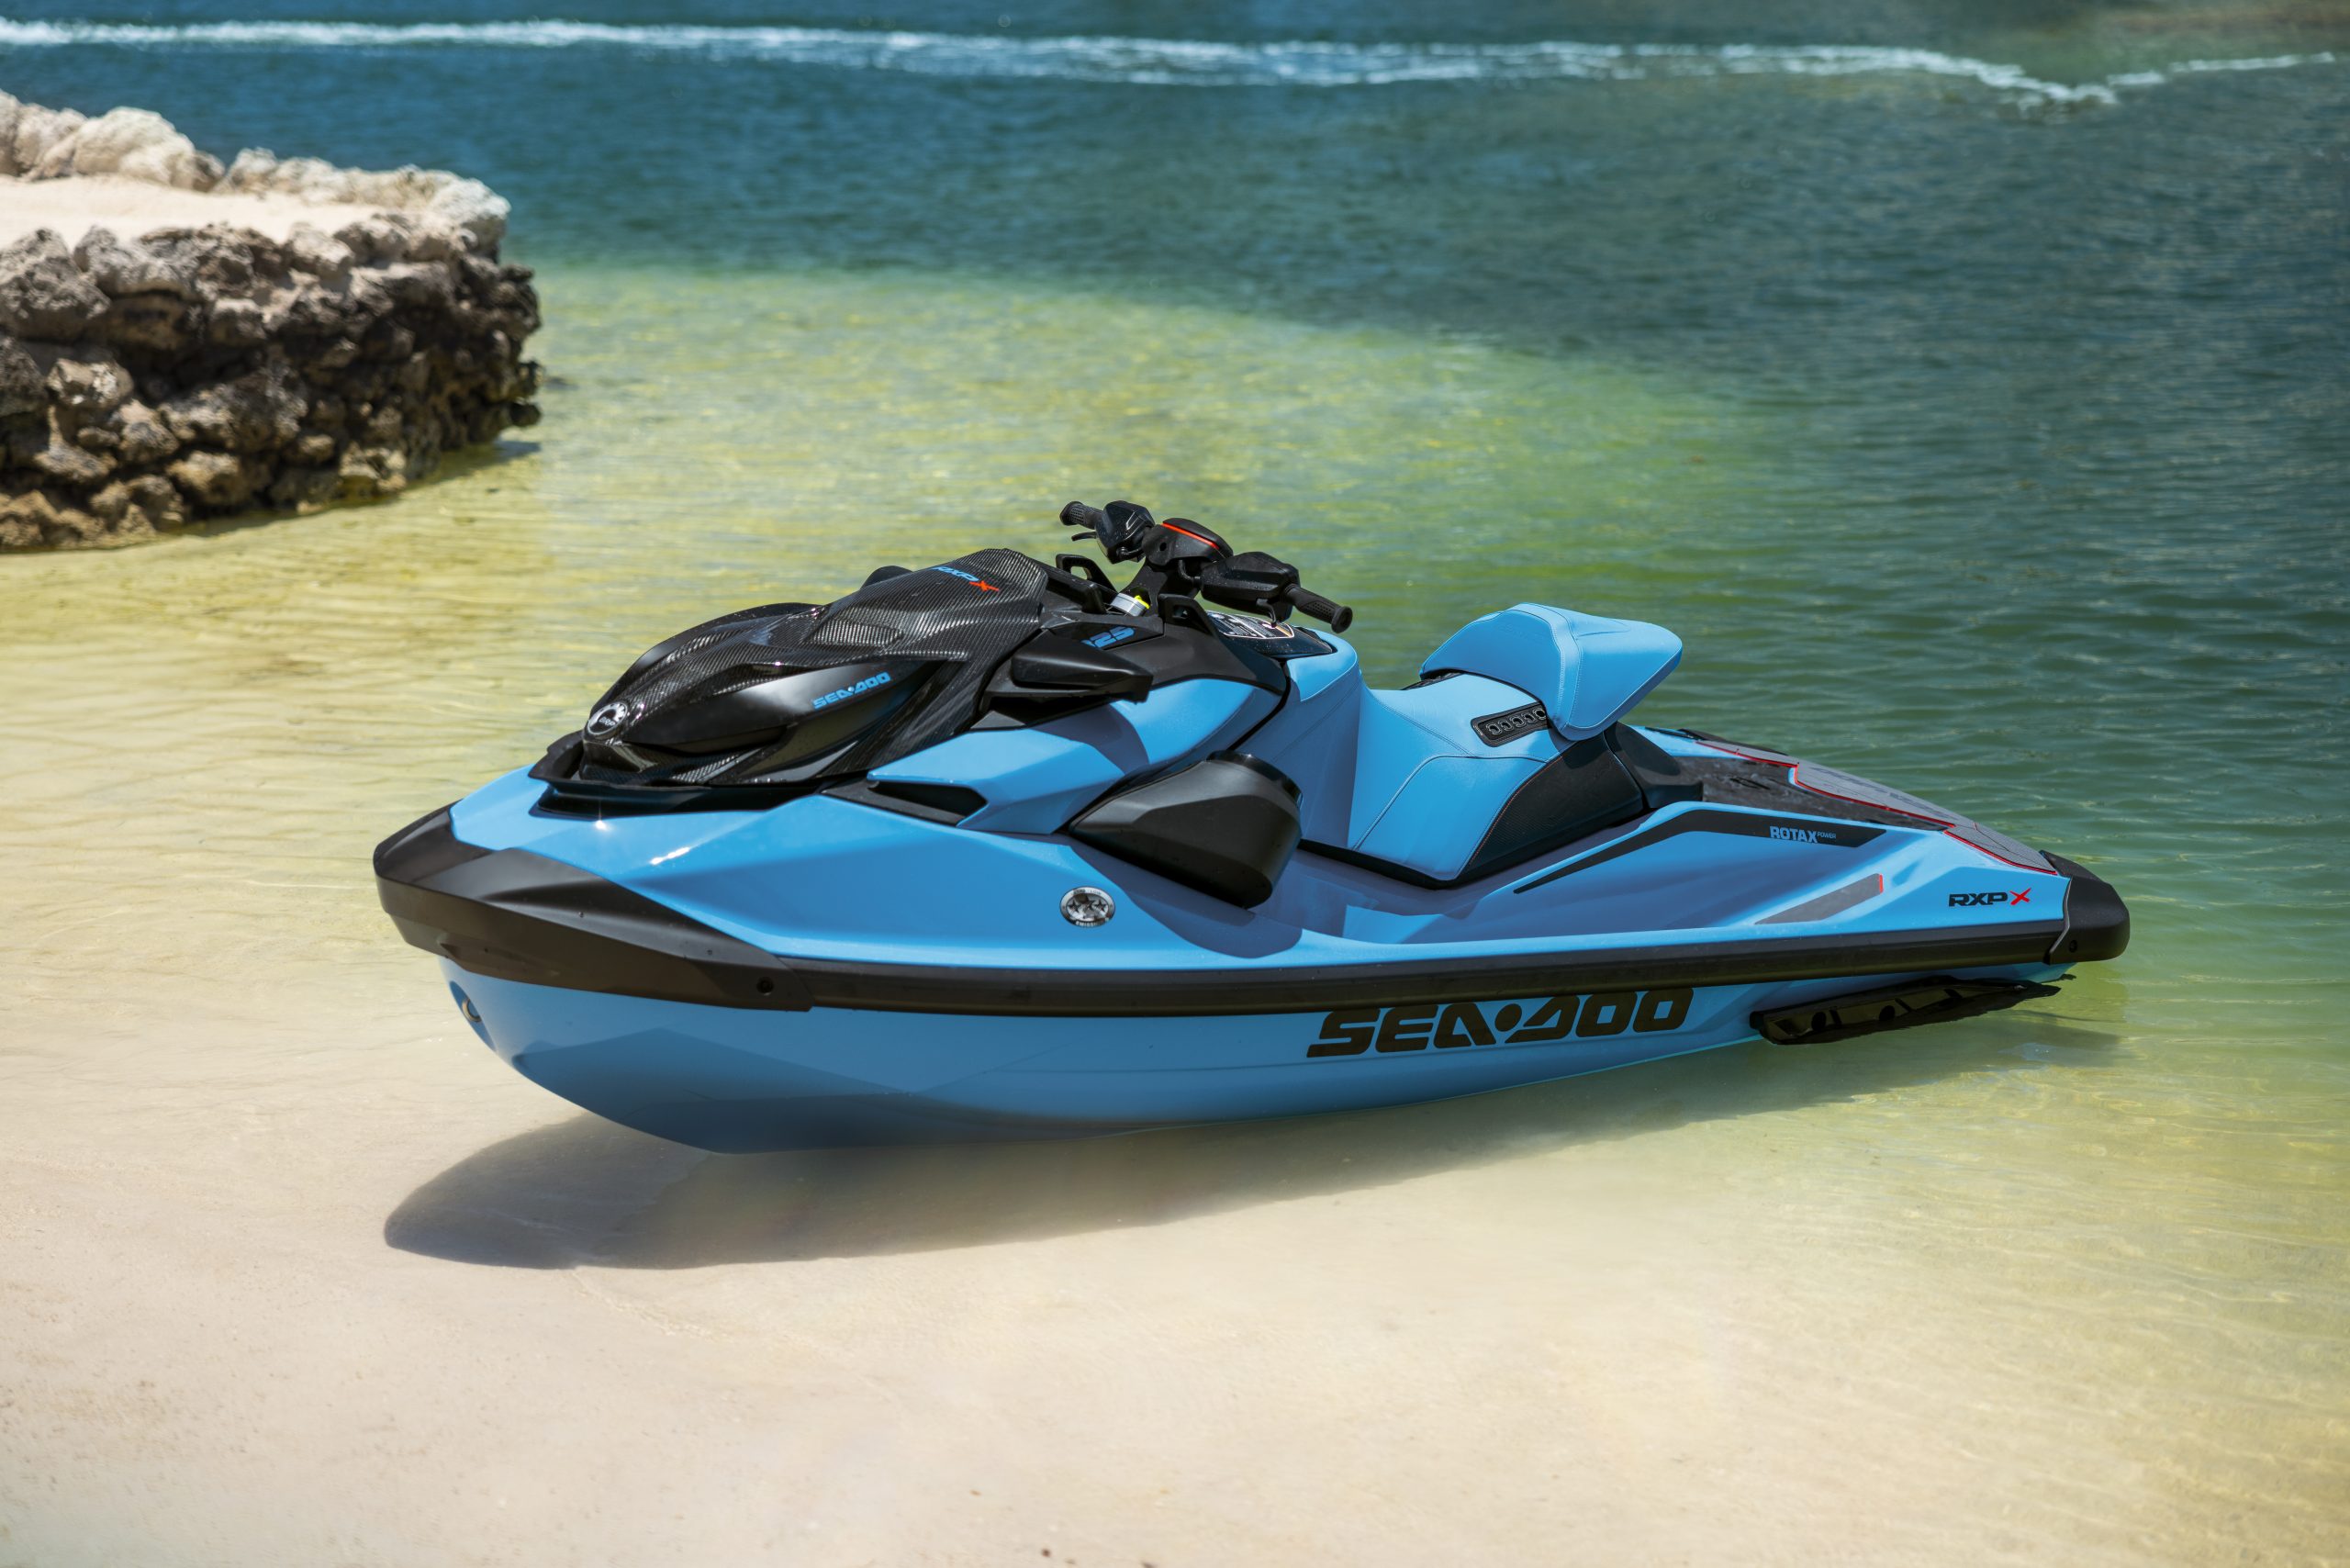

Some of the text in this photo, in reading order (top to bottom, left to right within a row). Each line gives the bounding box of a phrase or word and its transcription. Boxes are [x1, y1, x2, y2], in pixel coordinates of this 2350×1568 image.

[1770, 826, 1837, 843] ROTAX POWER
[1949, 892, 2009, 907] RXP
